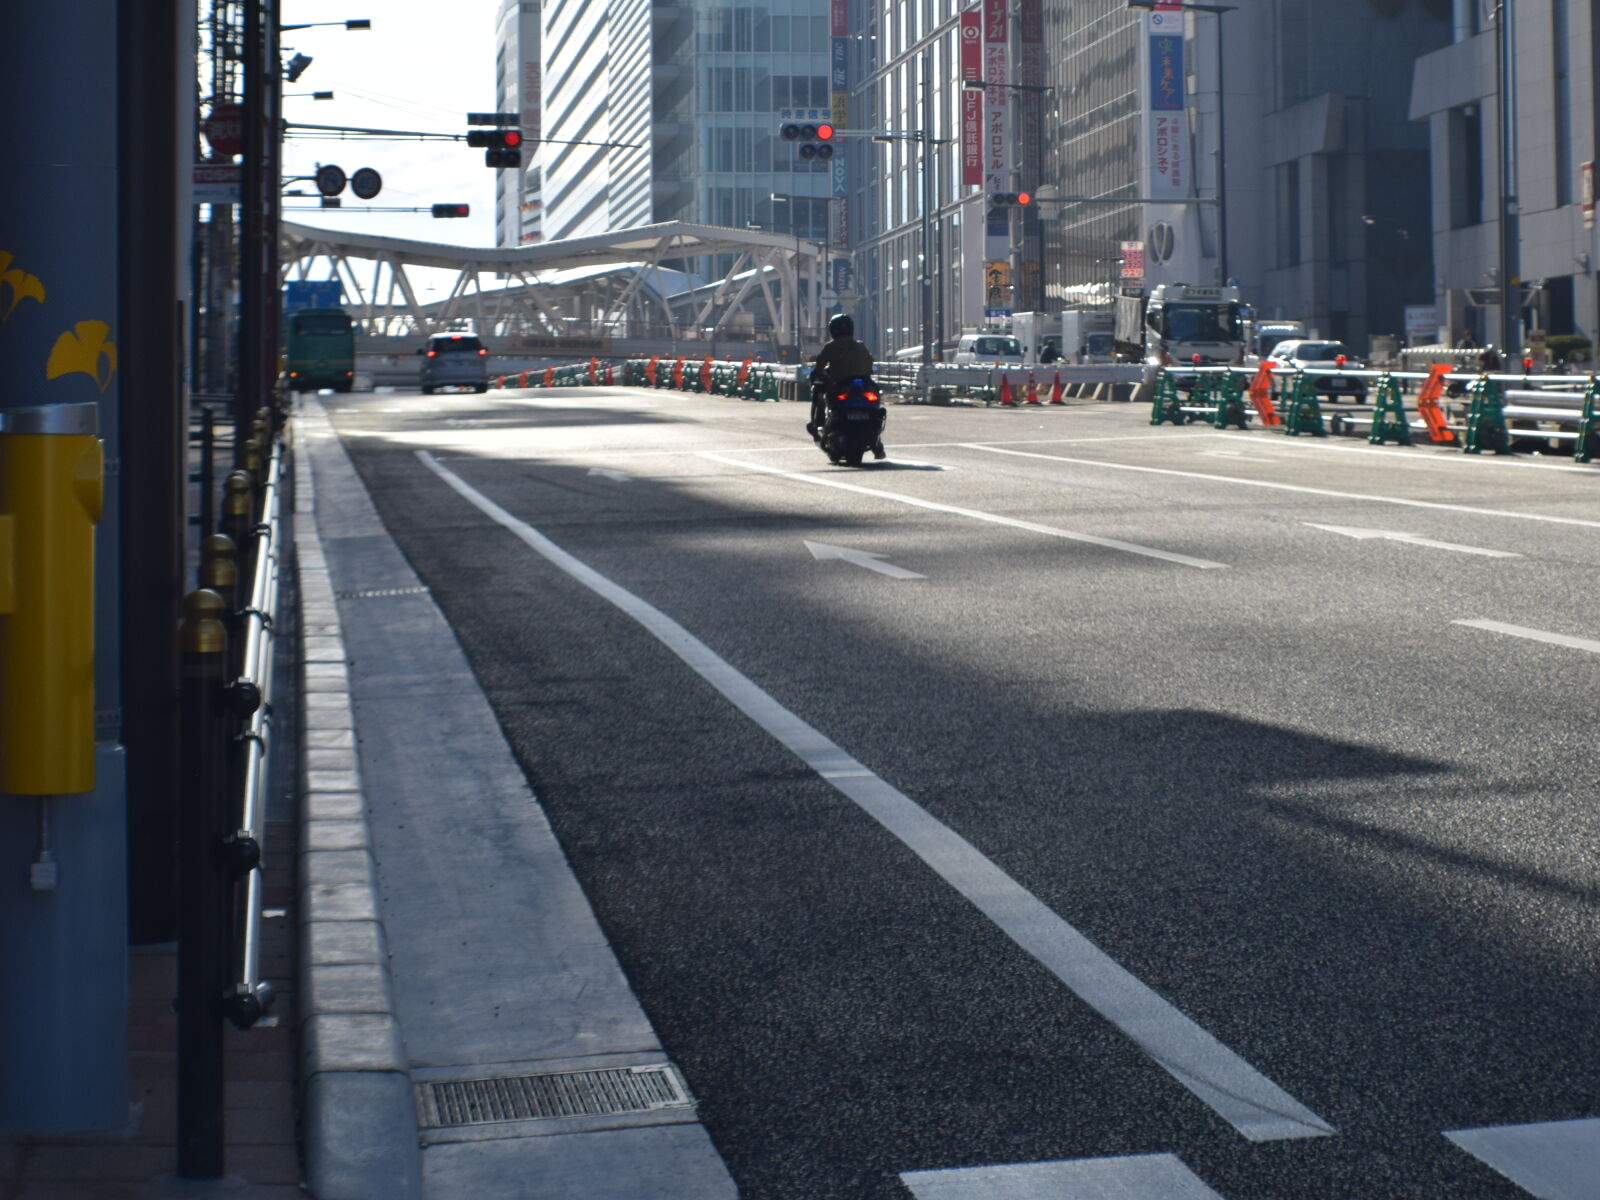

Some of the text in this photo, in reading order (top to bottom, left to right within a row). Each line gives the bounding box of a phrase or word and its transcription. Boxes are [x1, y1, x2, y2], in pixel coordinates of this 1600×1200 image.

[987, 47, 997, 106] アポロシネマ
[965, 67, 977, 167] 三UFJ信託銀行
[991, 111, 1004, 170] アポロビル
[1155, 117, 1168, 176] アポロシネマ
